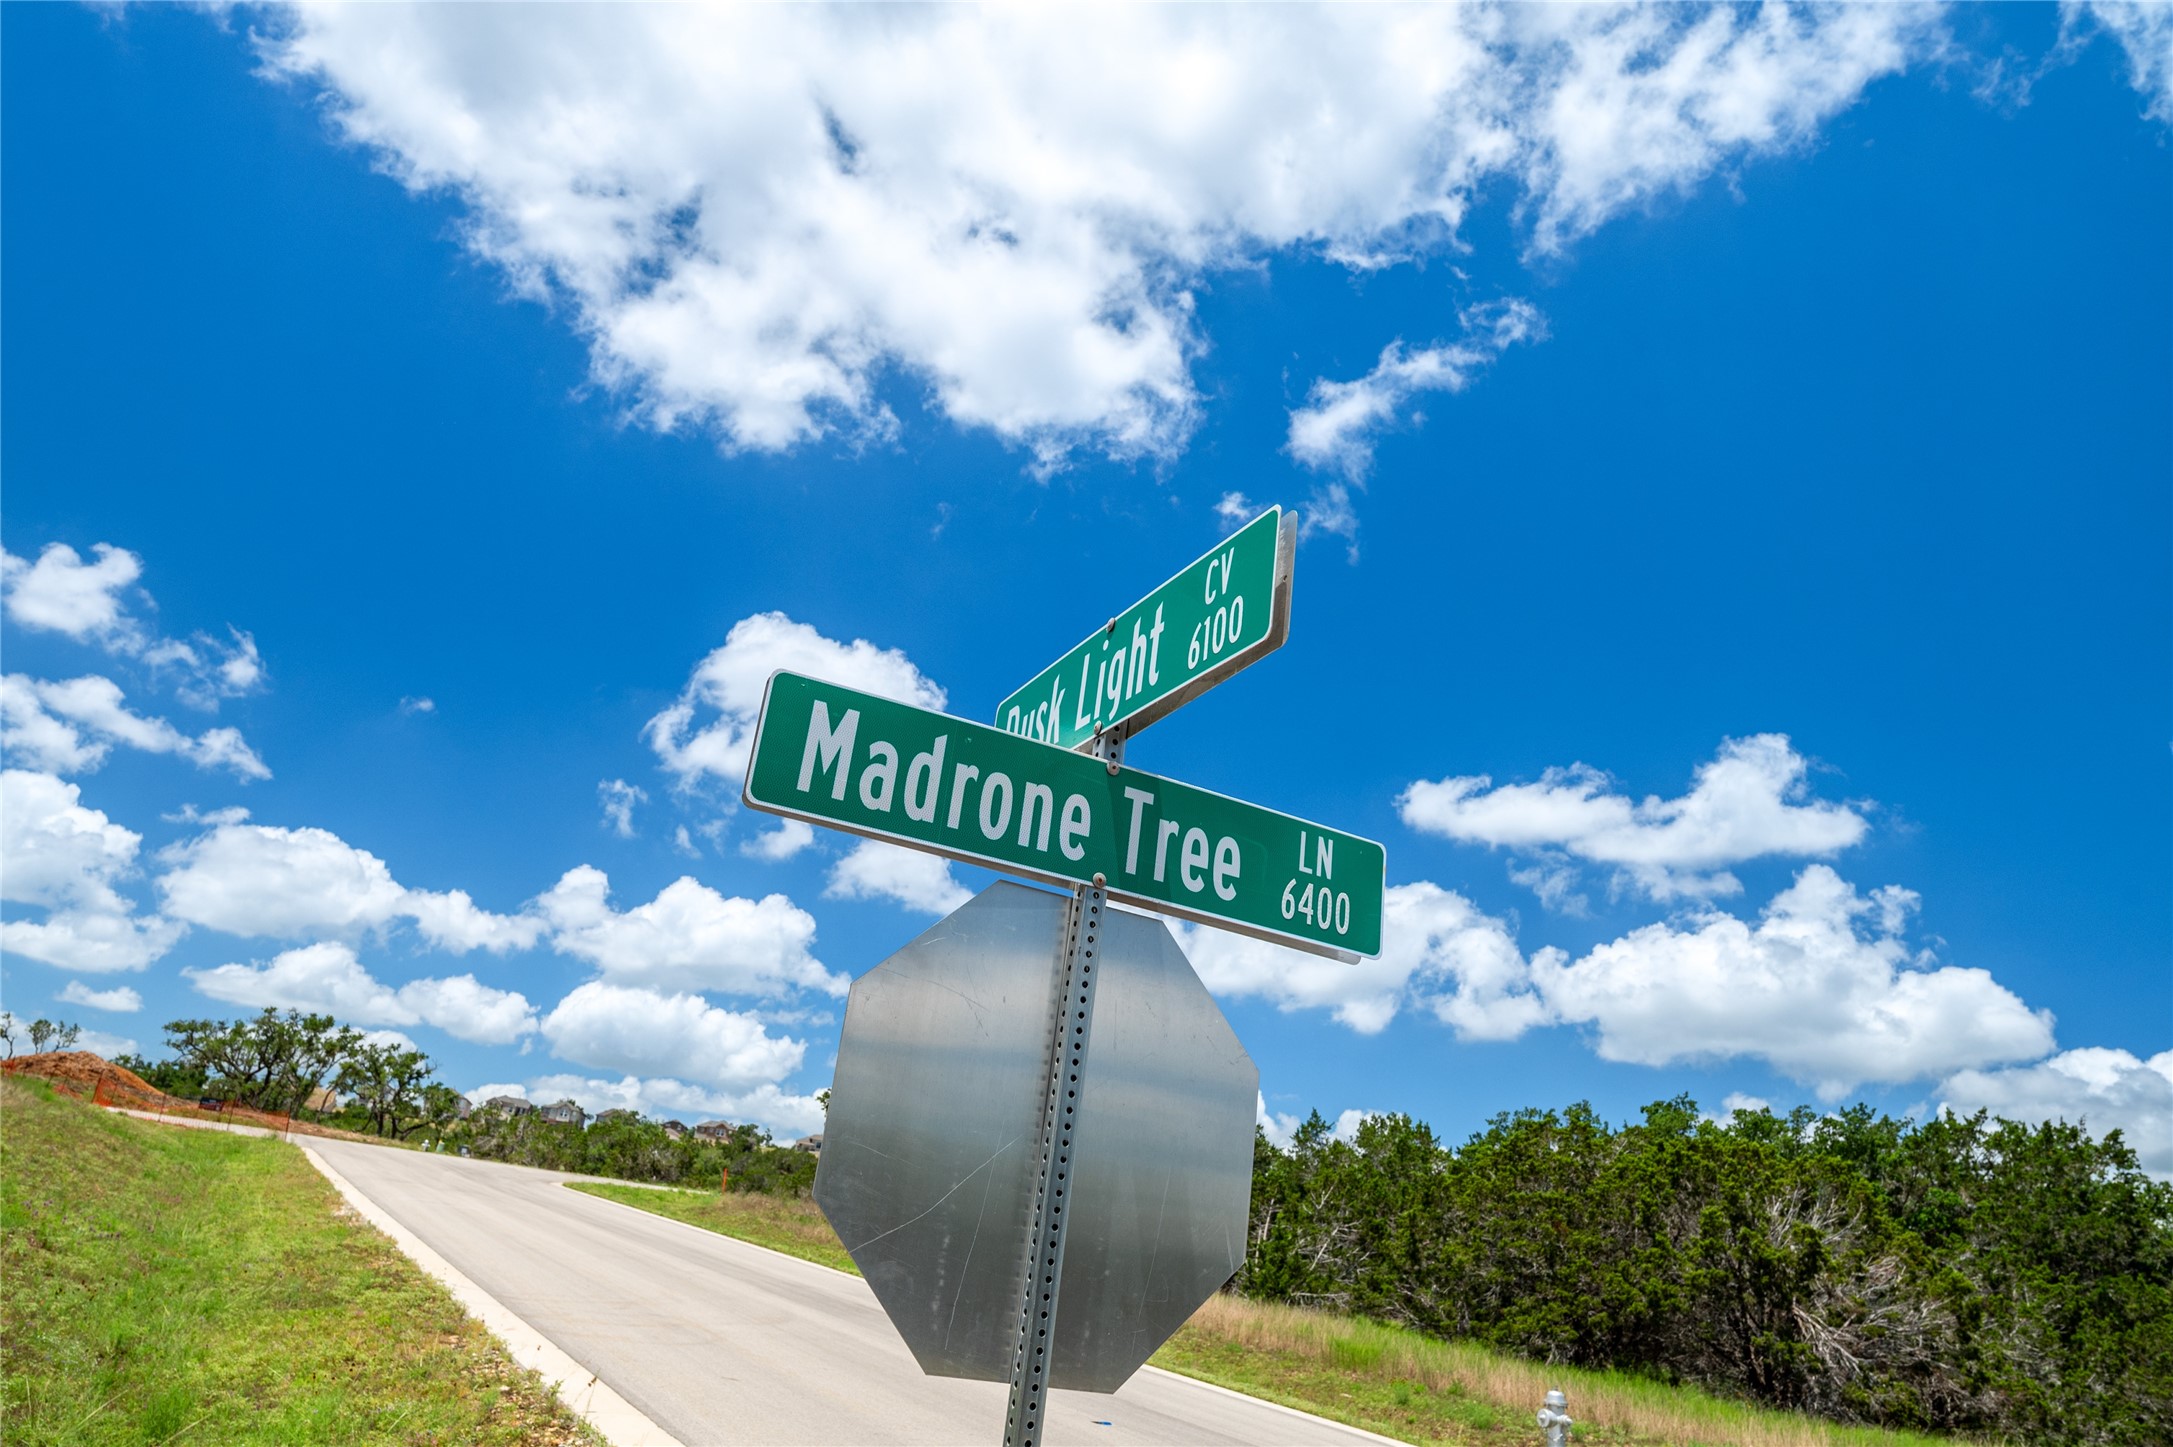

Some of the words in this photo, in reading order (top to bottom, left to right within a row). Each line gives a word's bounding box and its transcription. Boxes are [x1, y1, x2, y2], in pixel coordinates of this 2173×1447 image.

[1205, 547, 1235, 605] CV
[1187, 595, 1244, 670] 6100
[1075, 601, 1165, 732] Light
[796, 699, 1092, 862] Madrone
[1123, 785, 1241, 901] Tree
[1298, 830, 1334, 880] LN
[1281, 878, 1350, 935] 6400
